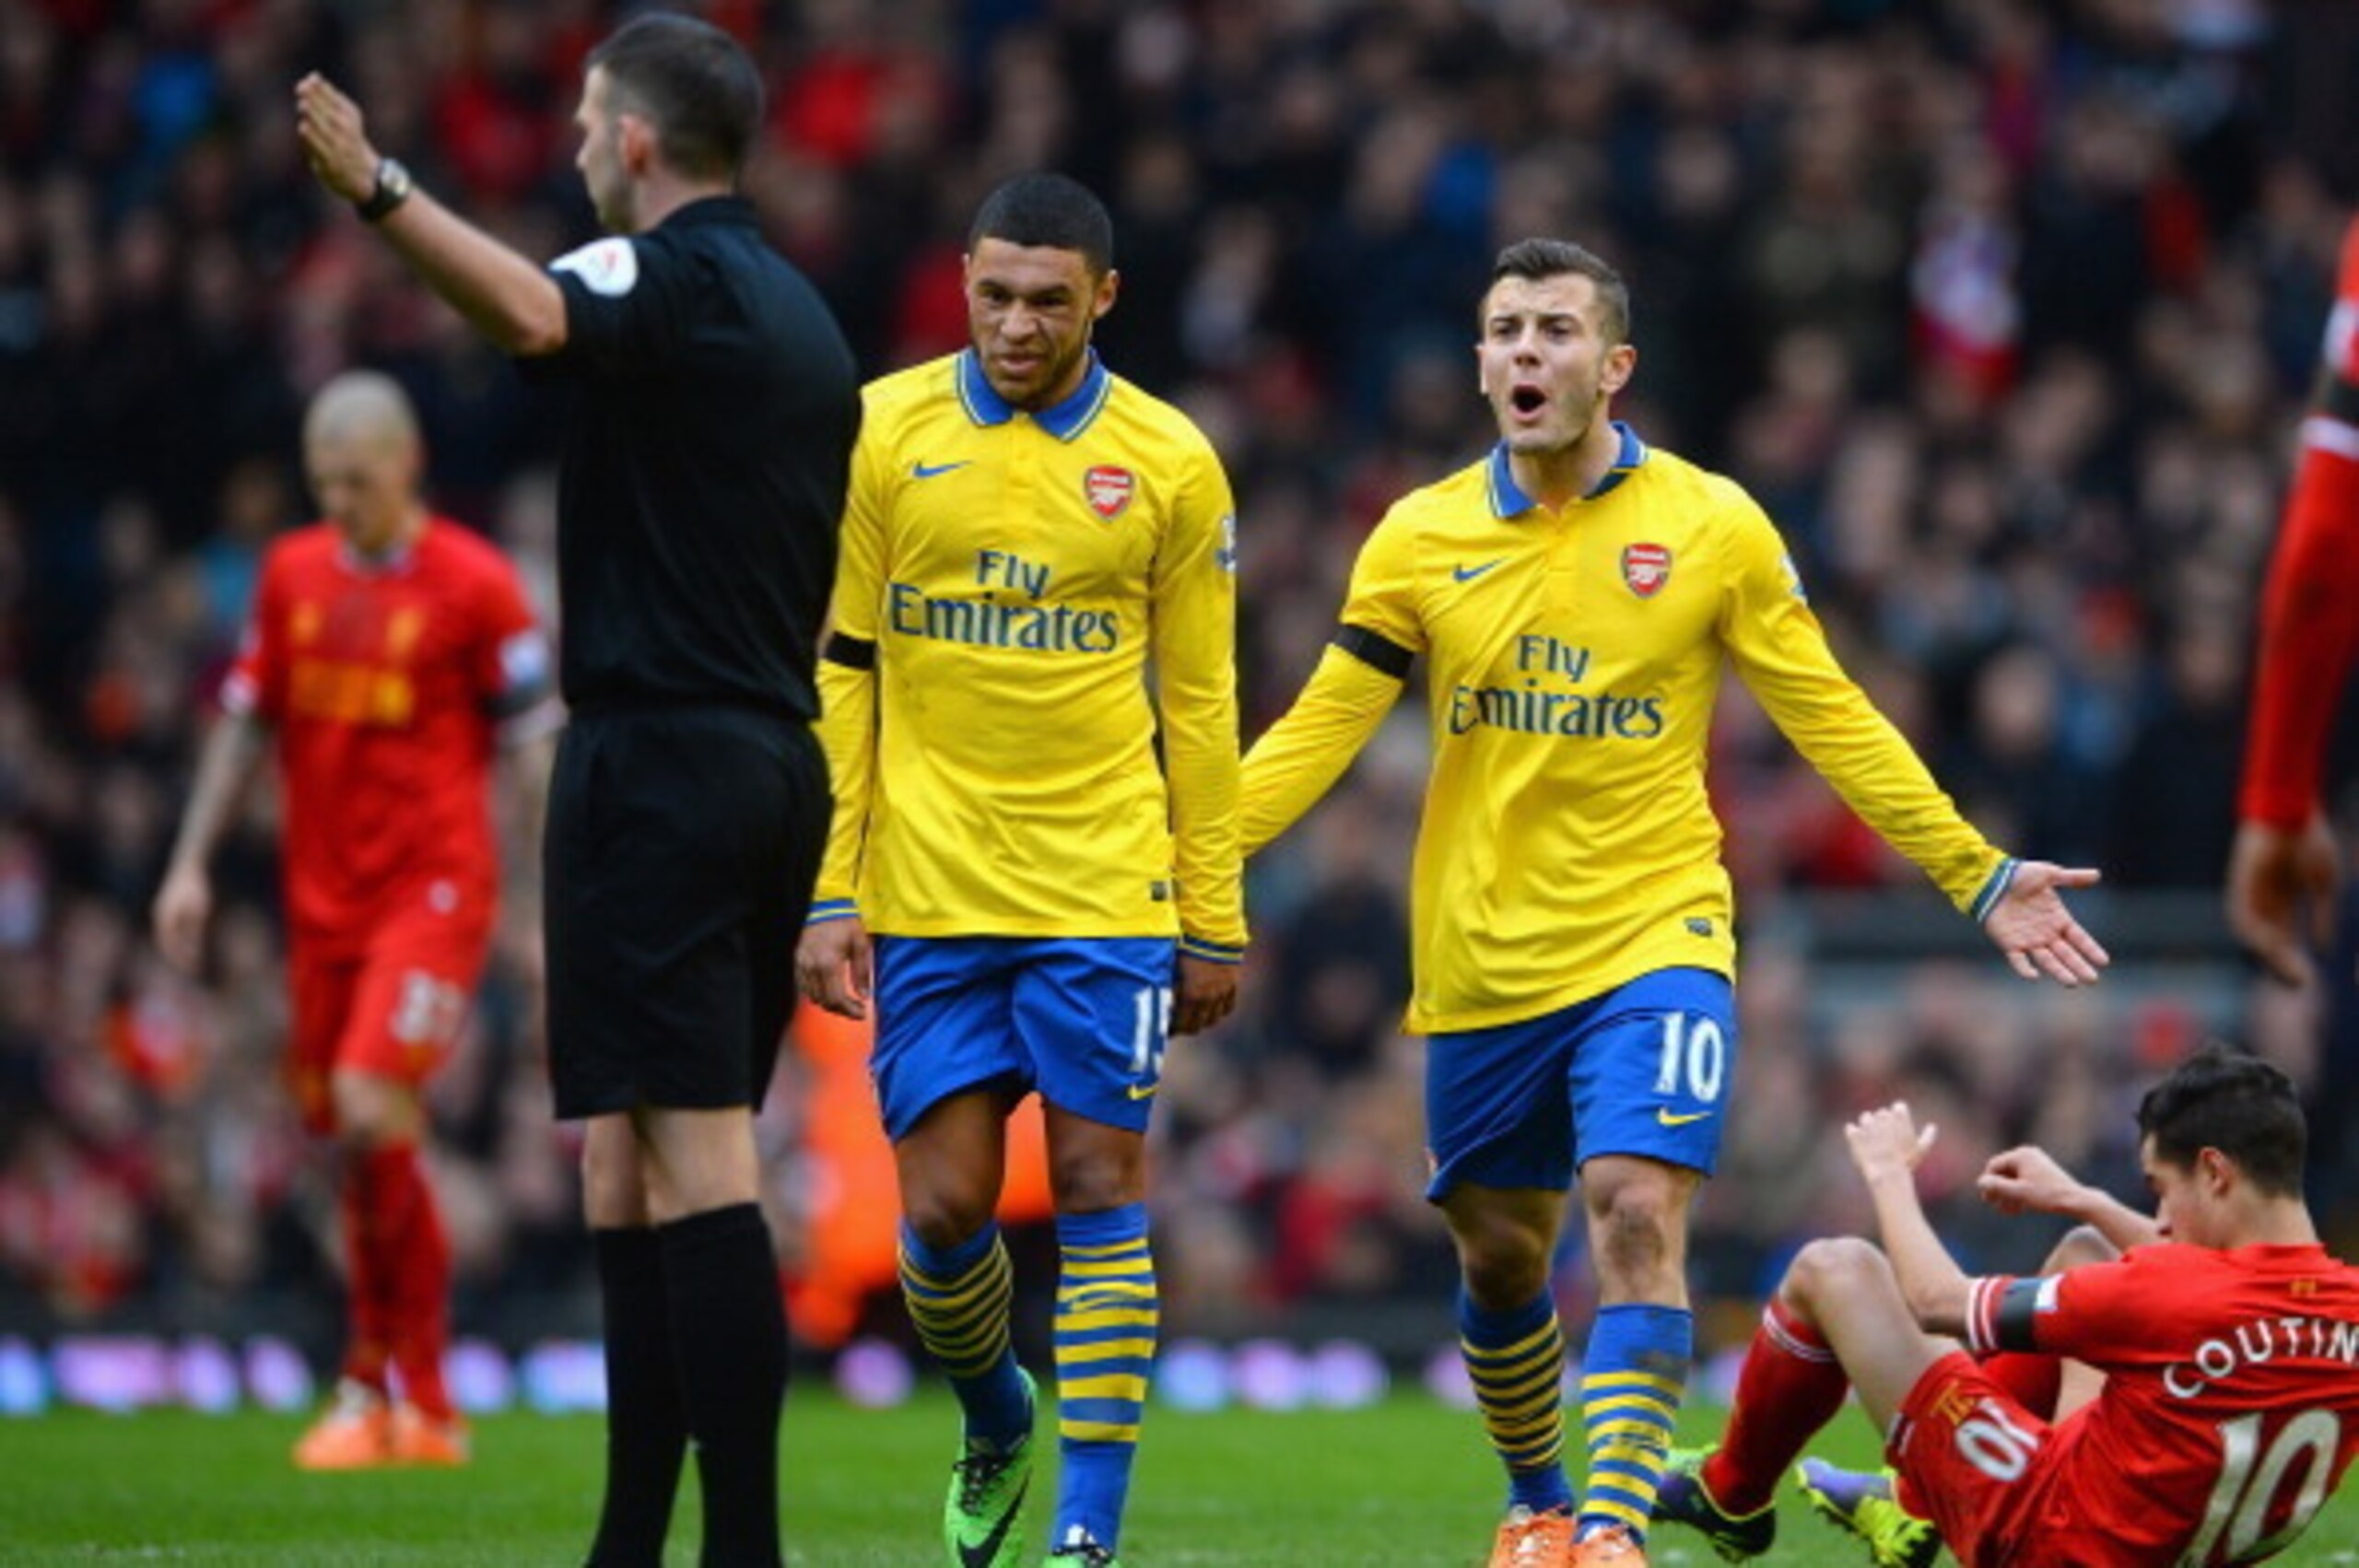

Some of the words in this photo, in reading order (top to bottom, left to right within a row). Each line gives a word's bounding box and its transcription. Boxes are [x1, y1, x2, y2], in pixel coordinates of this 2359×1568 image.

[976, 548, 1050, 597] Fly
[887, 581, 1119, 653] Emirates
[1517, 634, 1590, 684] Fly
[1449, 677, 1663, 738] Emirates
[1652, 1011, 1724, 1104] 10
[2173, 1408, 2341, 1568] 10
